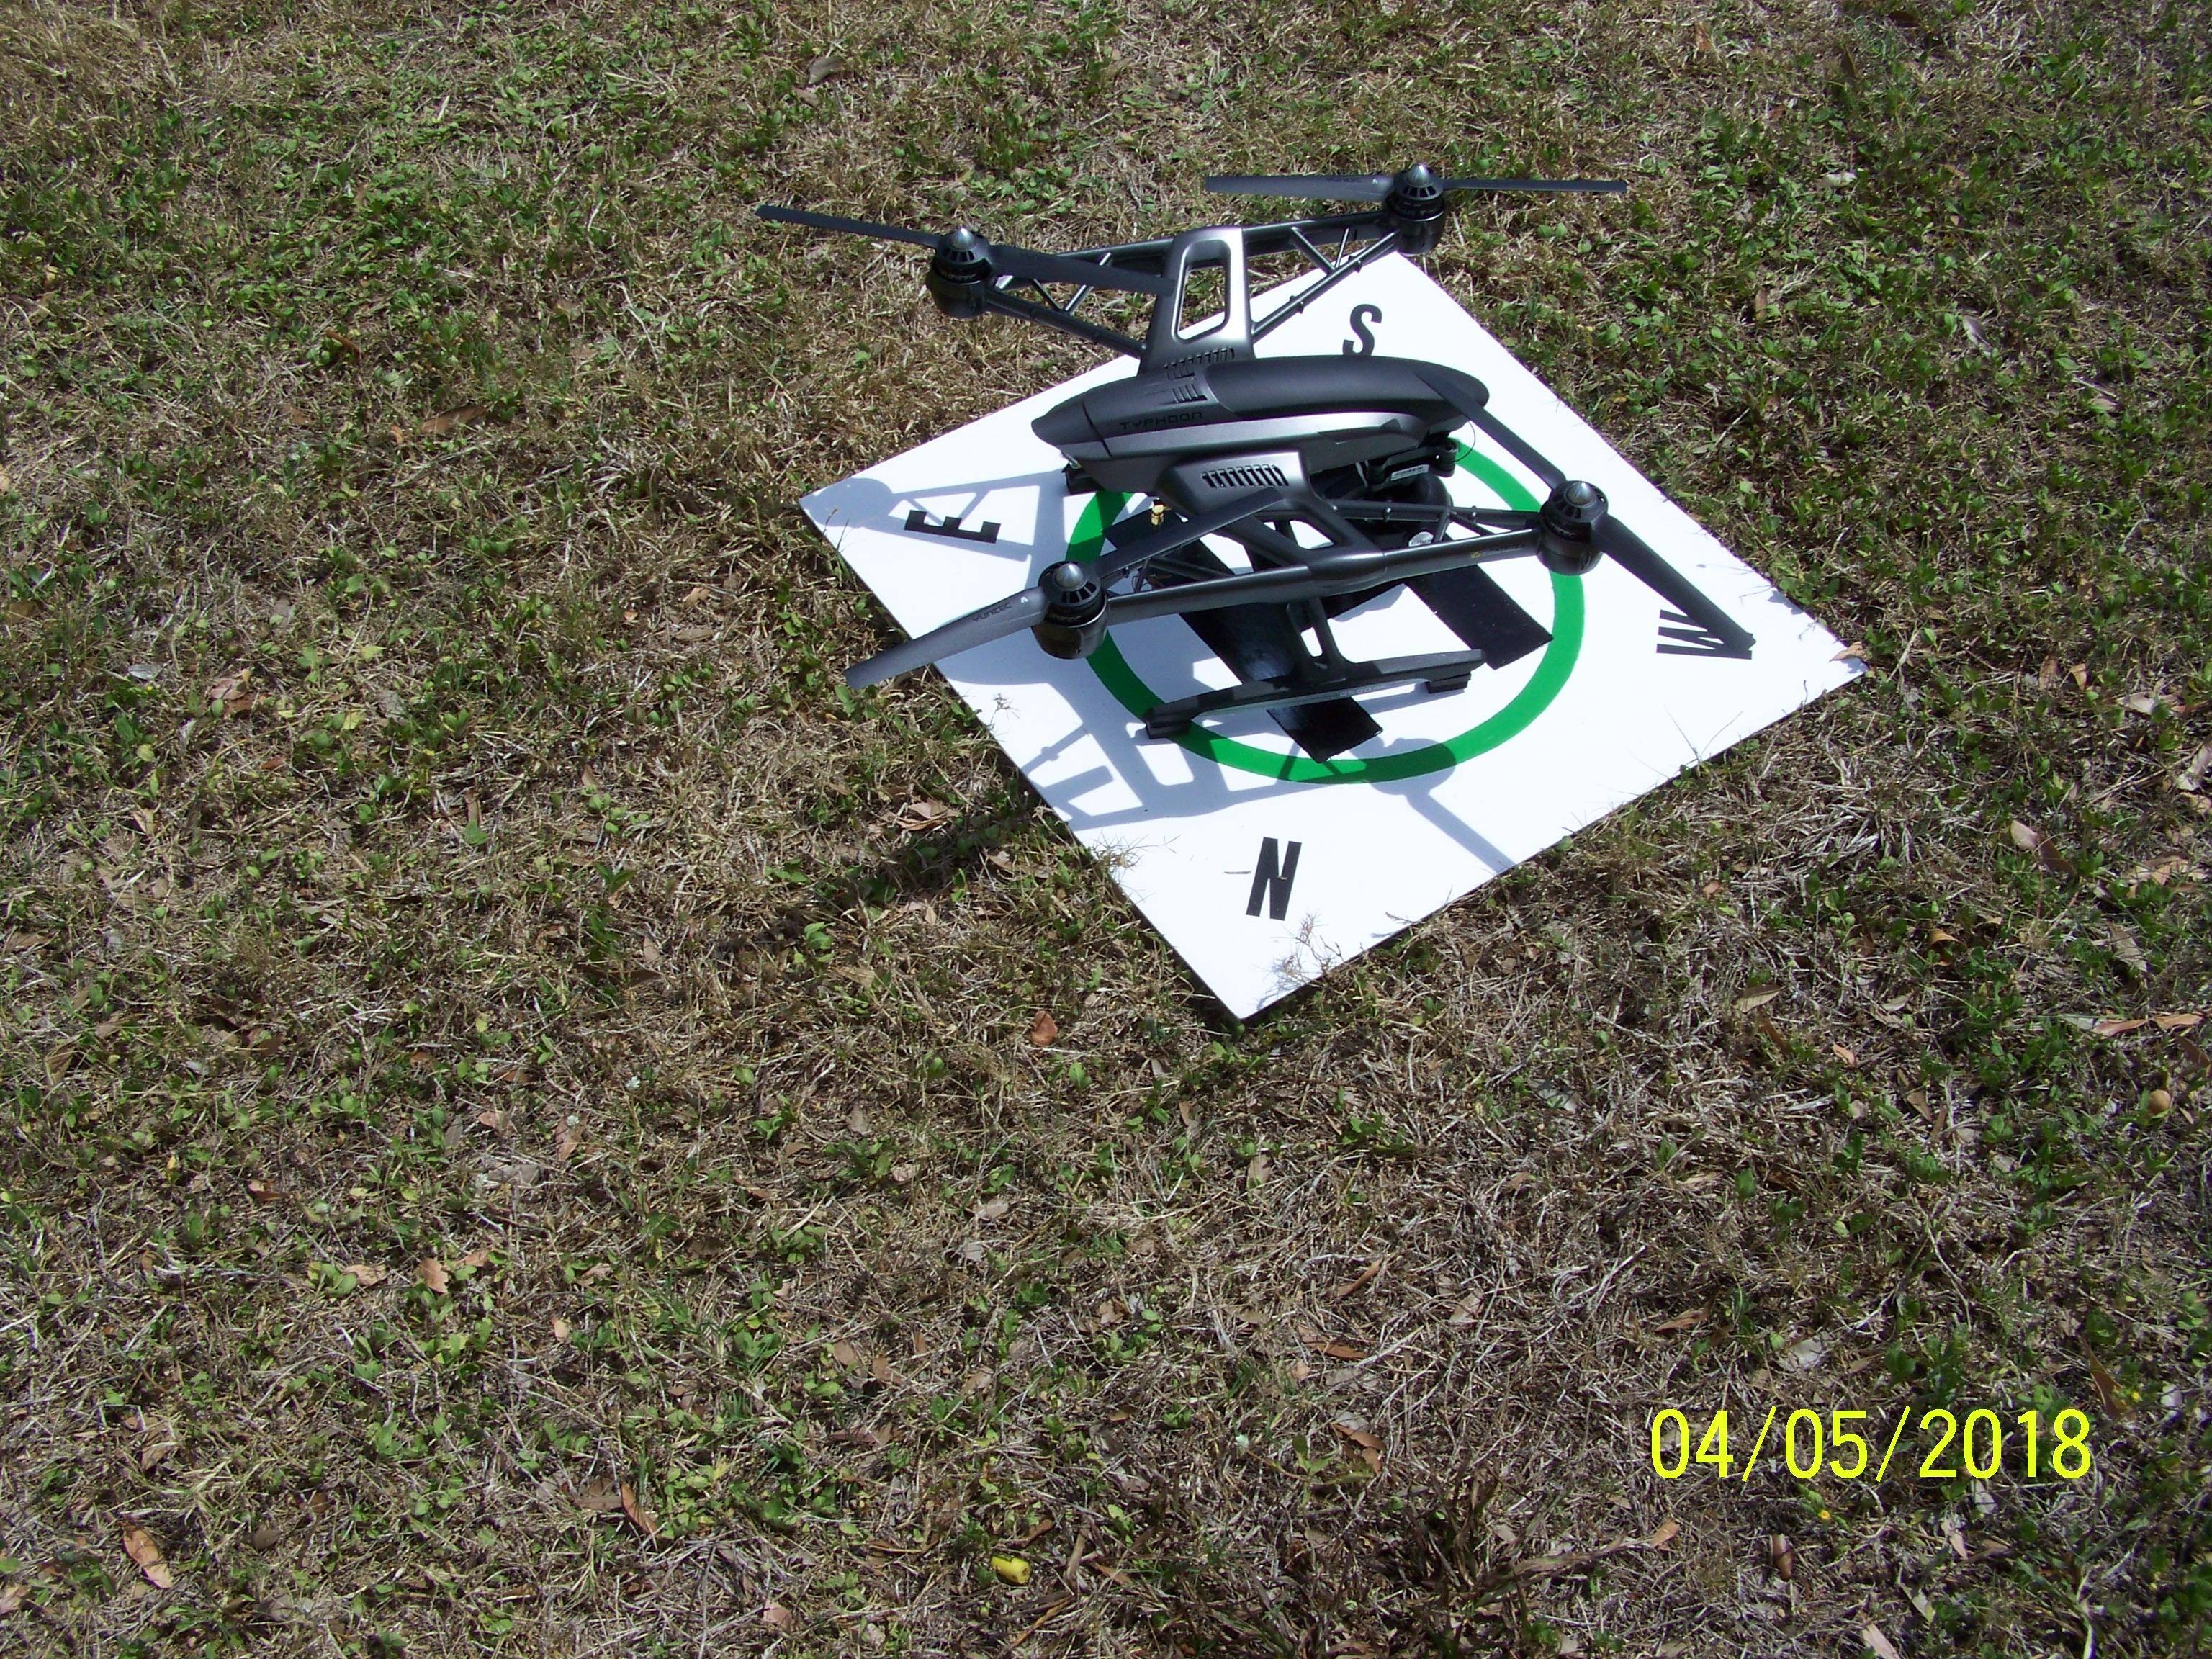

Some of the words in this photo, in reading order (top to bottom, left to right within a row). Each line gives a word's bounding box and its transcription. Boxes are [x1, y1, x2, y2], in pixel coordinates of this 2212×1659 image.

[1342, 304, 1382, 356] S
[1120, 411, 1202, 430] TYPHOON
[904, 509, 1001, 544] E
[1246, 837, 1302, 921] N
